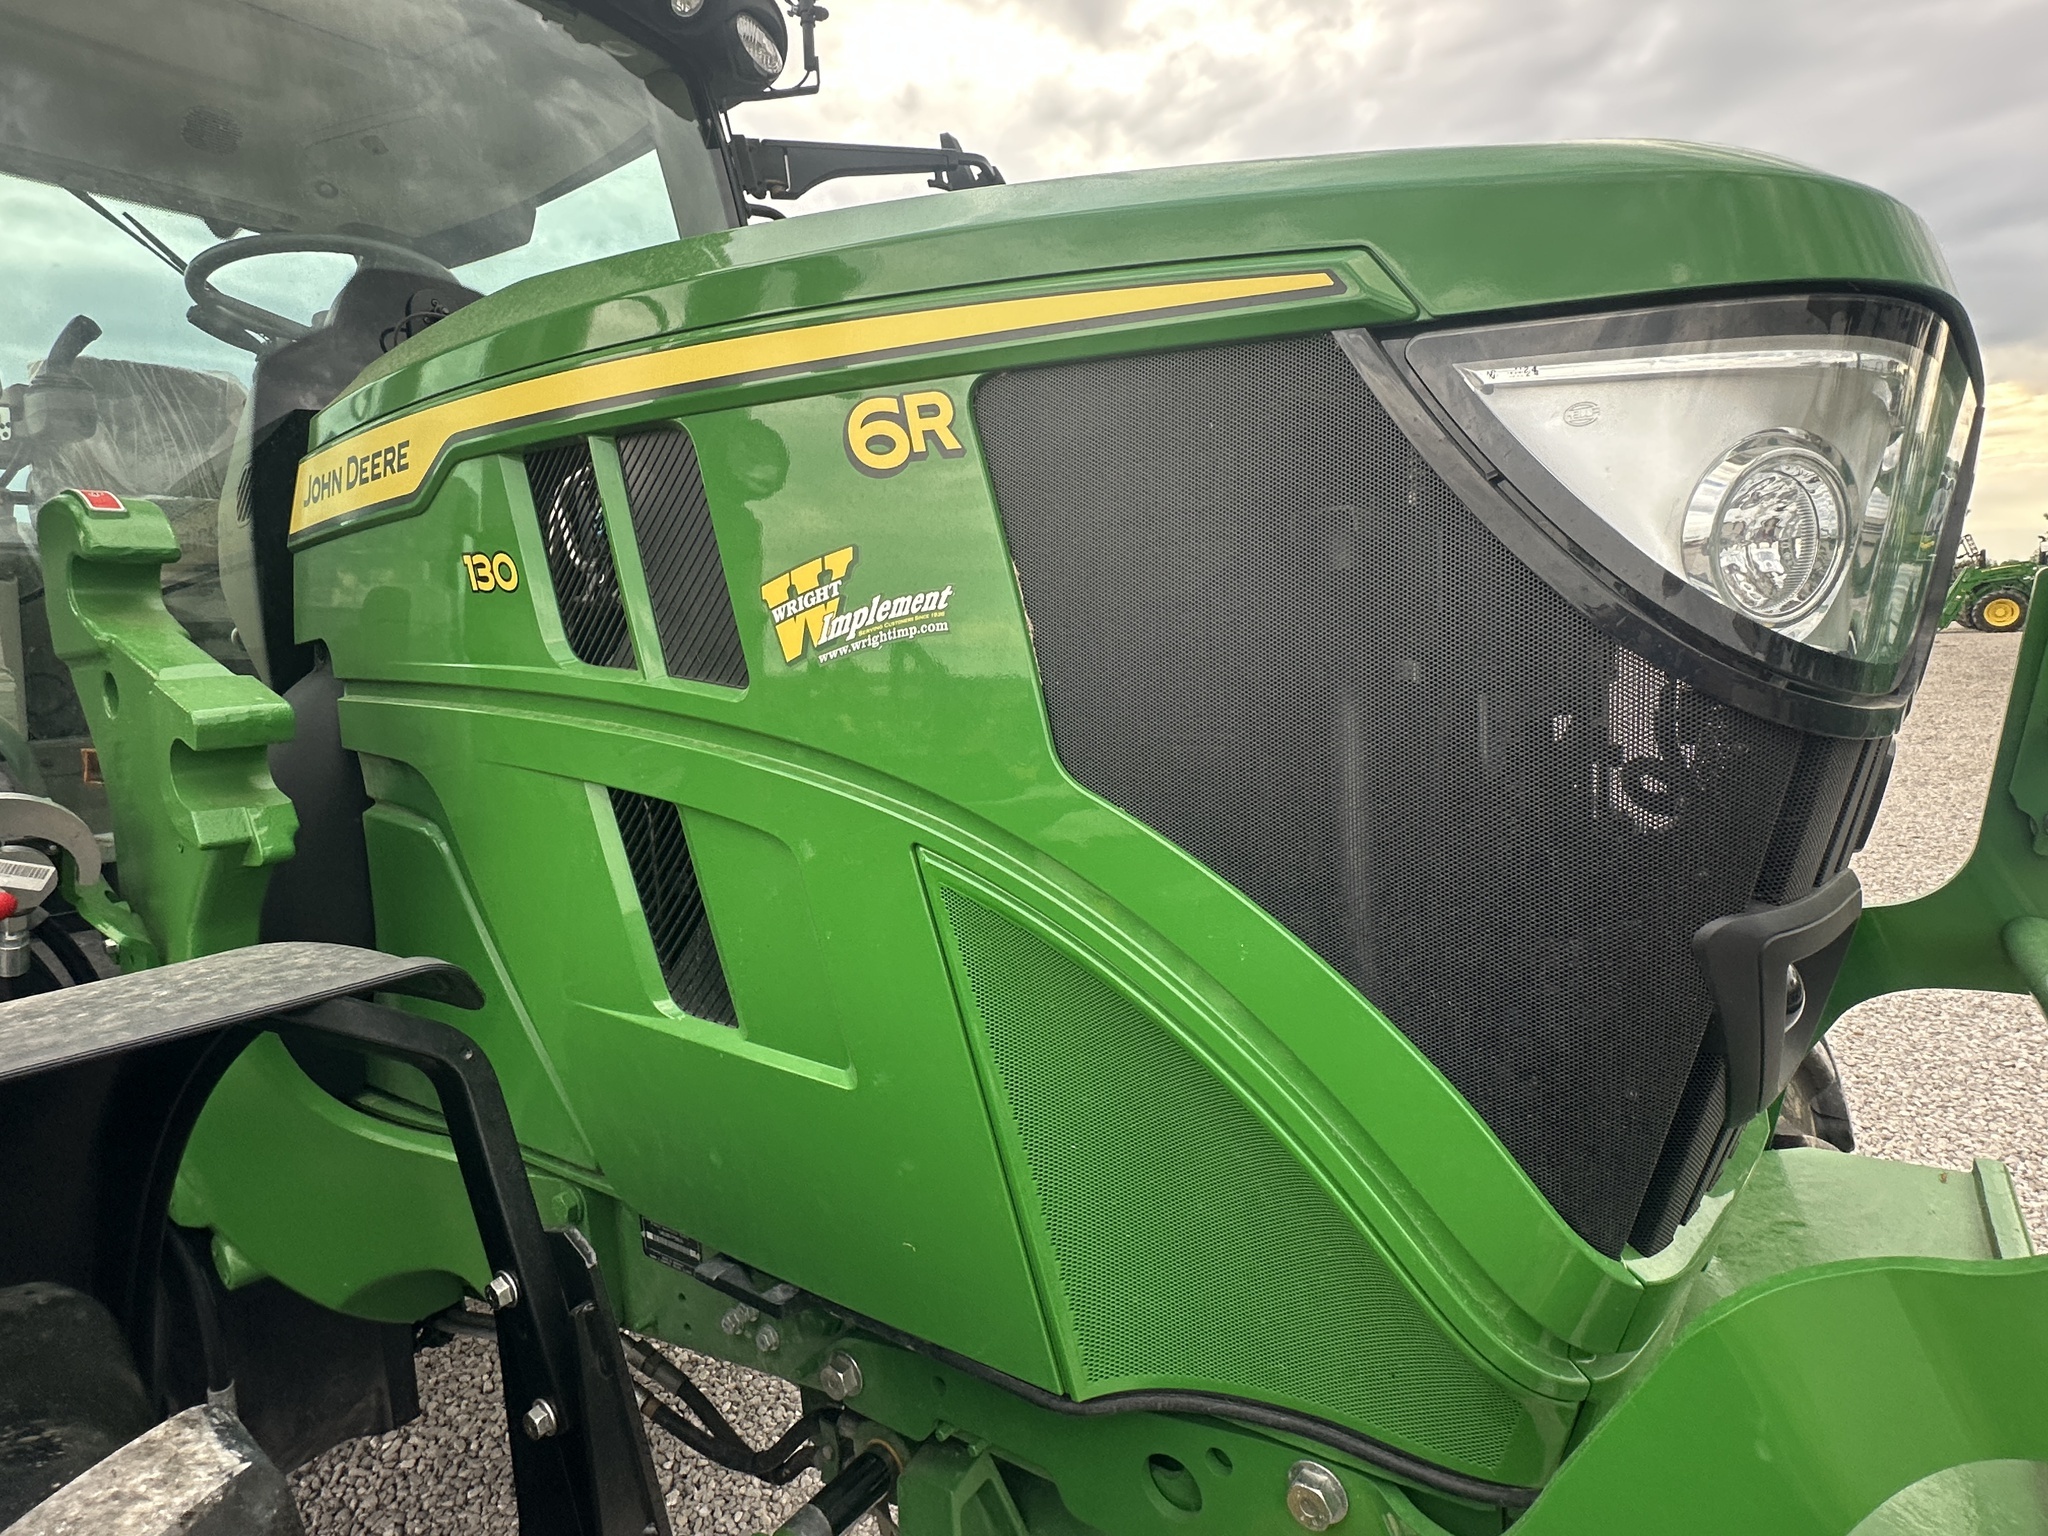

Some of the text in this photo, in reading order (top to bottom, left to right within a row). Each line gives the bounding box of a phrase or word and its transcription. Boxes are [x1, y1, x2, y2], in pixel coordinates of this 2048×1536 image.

[844, 389, 967, 479] 6R
[304, 440, 410, 507] JOHN DEERE
[462, 552, 519, 593] 130
[771, 580, 842, 623] WRIGHT
[817, 585, 953, 645] Implement
[818, 620, 949, 664] www.wrightimp.com
